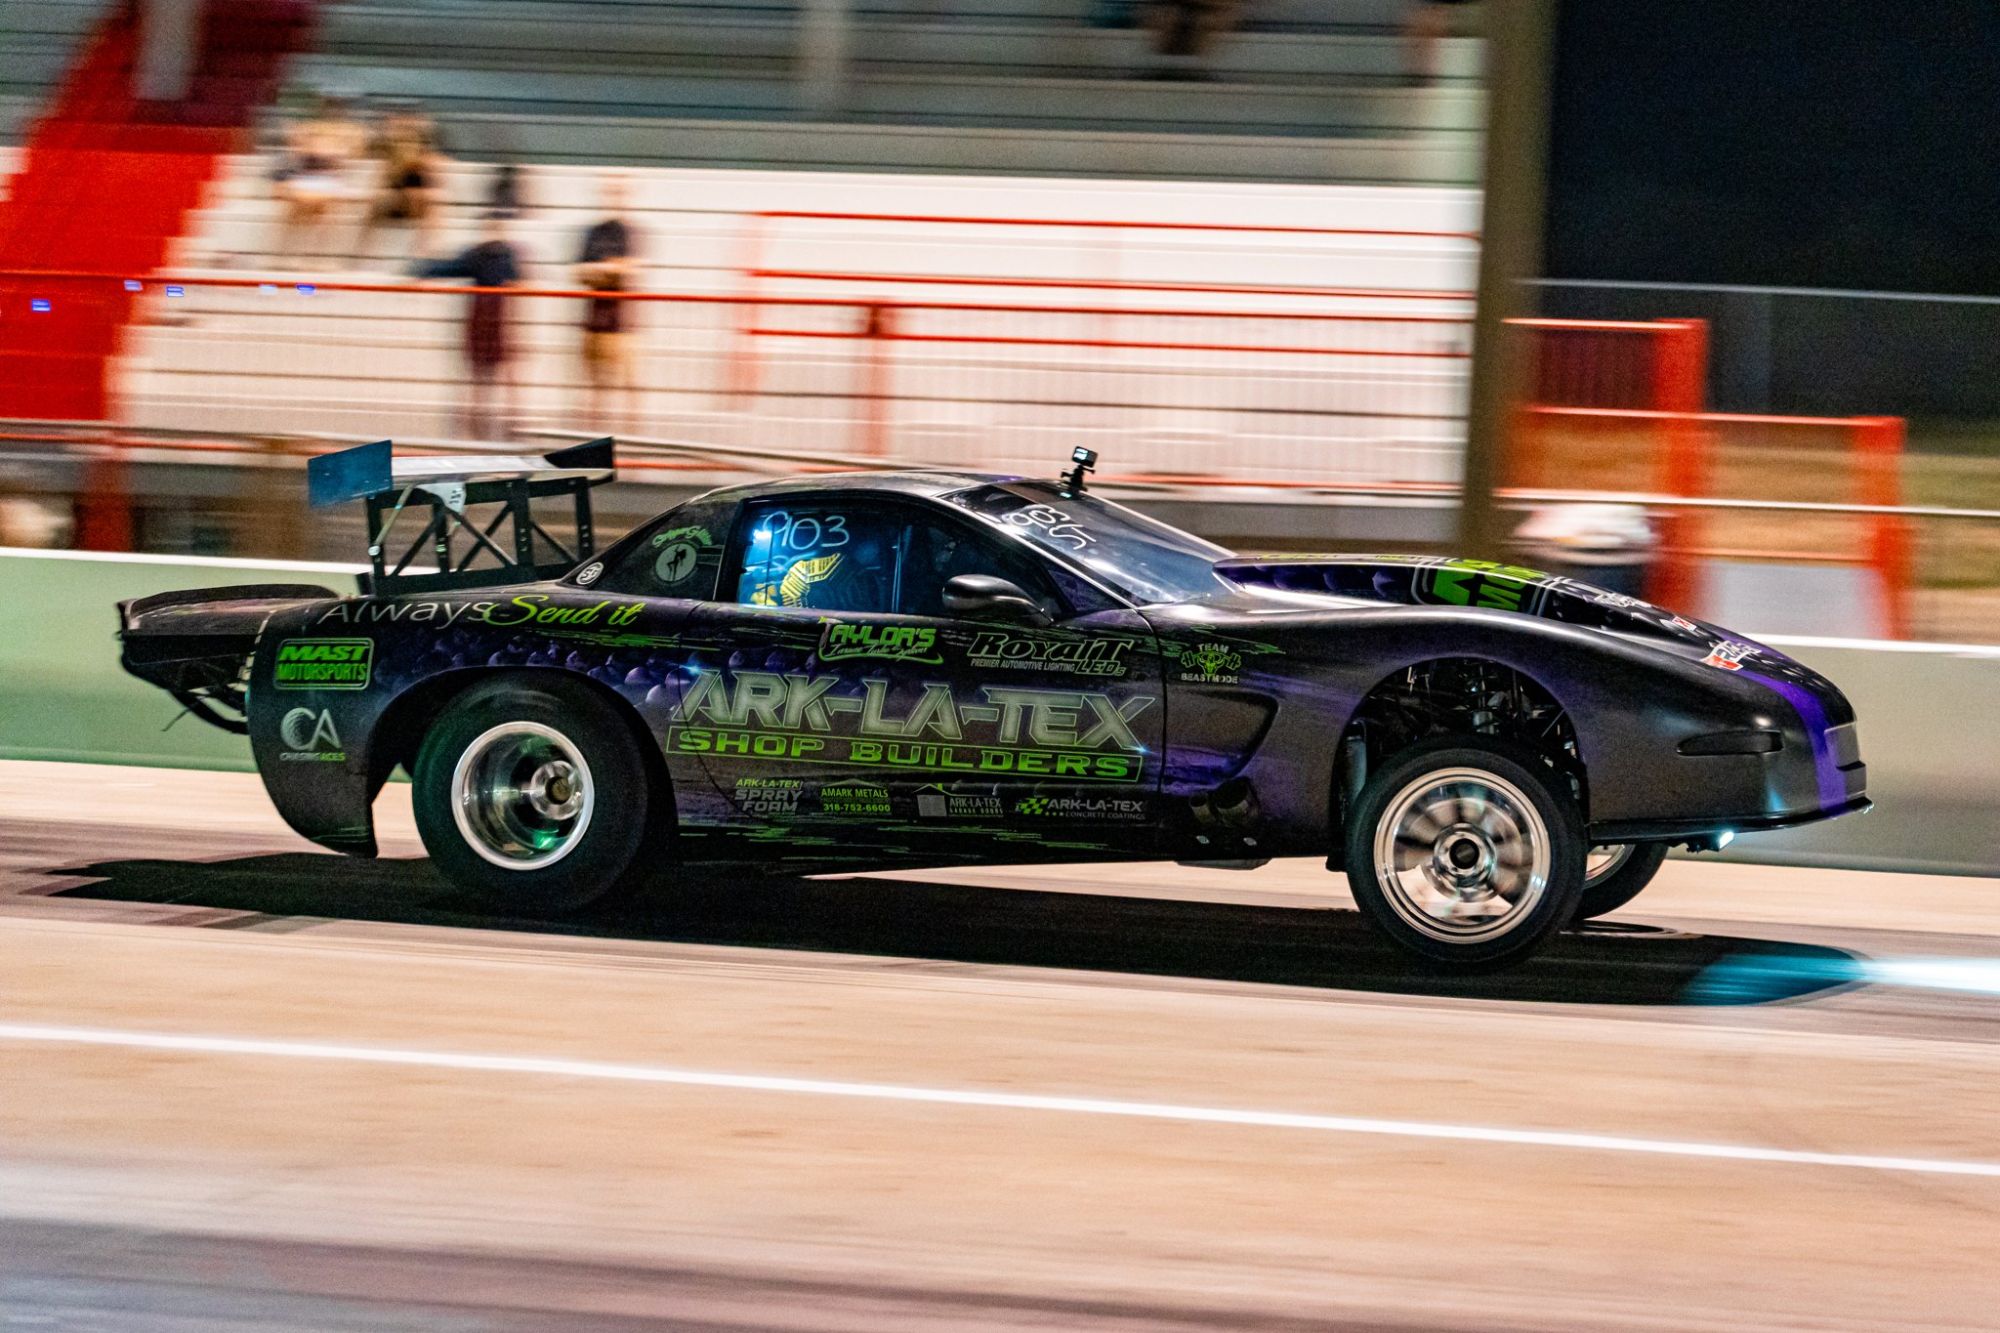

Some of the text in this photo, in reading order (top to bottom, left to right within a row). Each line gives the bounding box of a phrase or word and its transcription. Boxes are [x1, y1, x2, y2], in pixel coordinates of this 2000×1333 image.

[762, 510, 850, 550] 903
[317, 594, 647, 630] Always Send it
[279, 645, 370, 660] MAST
[1196, 642, 1230, 654] TEAM
[277, 663, 367, 680] MOTORSPORTS
[970, 658, 1075, 672] PREMIER AUTOMOTIVE LIGHTING
[671, 668, 1156, 749] ARK-LA-TEX
[679, 731, 1129, 777] SHOP BUILDERS
[735, 778, 800, 789] ARK-LA-TEX
[734, 789, 803, 801] SPRAY
[821, 788, 889, 799] AMARK METALS
[742, 801, 798, 813] FOAM
[949, 797, 1001, 808] ARK-LA-TEX
[1047, 798, 1144, 813] ARK-LA-TEX
[1065, 810, 1146, 820] CONCRETE COATINGS
